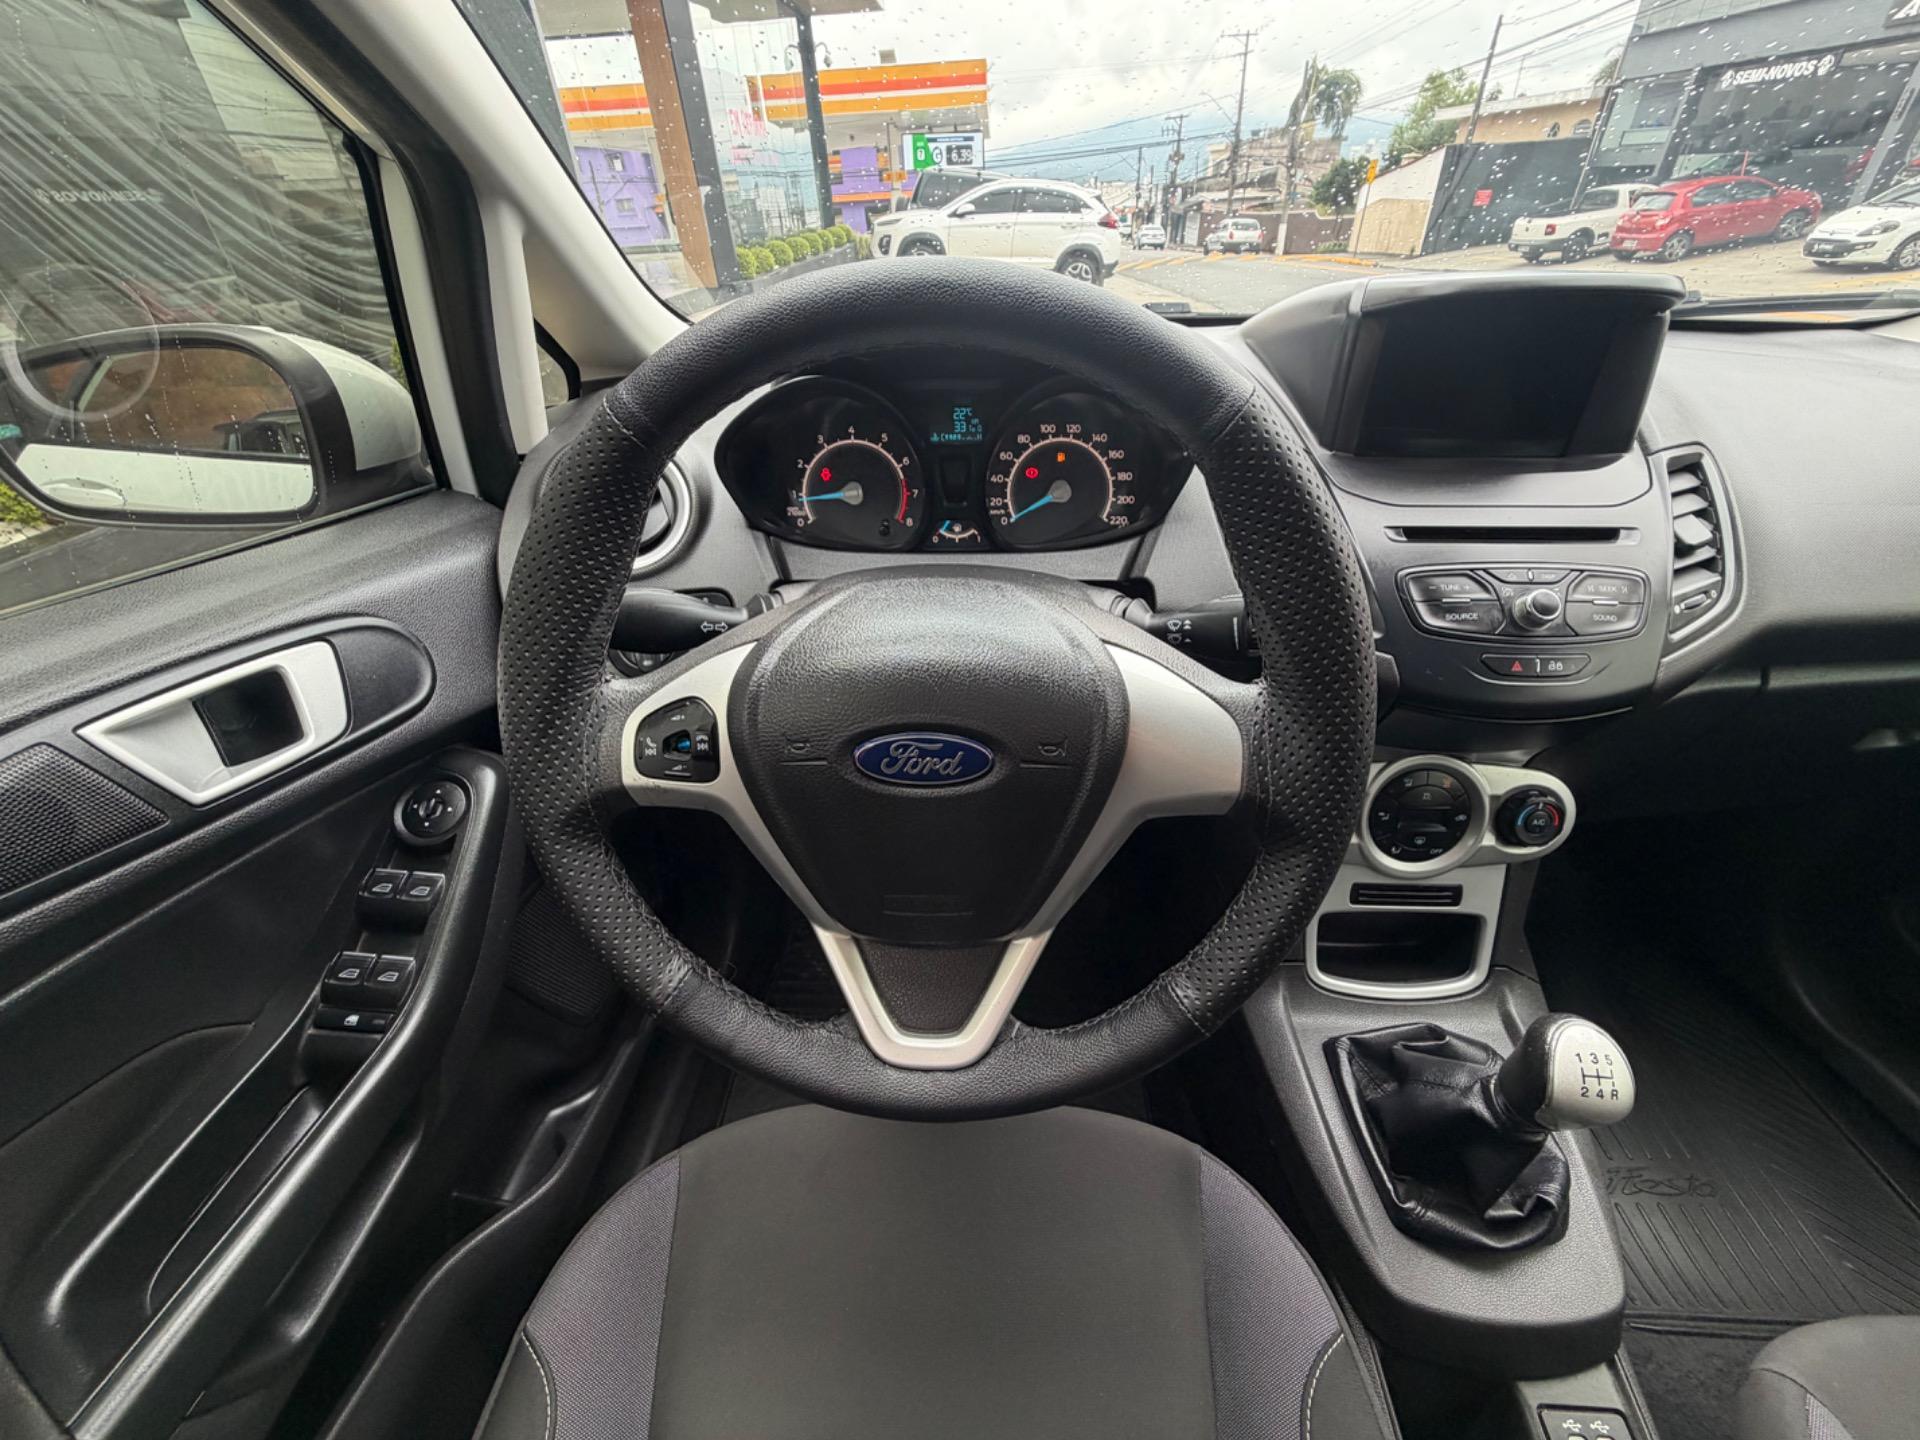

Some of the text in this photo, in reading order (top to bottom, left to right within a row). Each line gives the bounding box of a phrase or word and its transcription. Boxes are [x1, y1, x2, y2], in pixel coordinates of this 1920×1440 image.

[848, 425, 855, 434] 4
[1040, 424, 1056, 433] 100
[1066, 424, 1081, 433] 120
[817, 434, 824, 444] 3
[881, 433, 888, 442] 5
[1017, 434, 1031, 443] 80
[1092, 433, 1108, 442] 140
[1000, 452, 1013, 461] 60
[1108, 450, 1125, 459] 160
[797, 459, 804, 469] 2
[902, 457, 910, 466] 6
[990, 474, 1004, 483] 40
[1117, 472, 1133, 481] 180
[912, 489, 919, 498] 7
[990, 498, 1003, 507] 20
[1117, 495, 1135, 504] 200
[797, 518, 804, 527] 0
[906, 517, 913, 527] 8
[1001, 518, 1008, 526] 0
[1109, 515, 1128, 525] 220
[932, 535, 939, 543] 0
[1440, 584, 1461, 592] TUNE
[1445, 612, 1479, 621] SOURCE
[1592, 613, 1618, 622] SOUND
[880, 741, 964, 776] Ford
[1575, 1052, 1613, 1066] 1 3 5
[1580, 1086, 1619, 1100] 2 4 R
